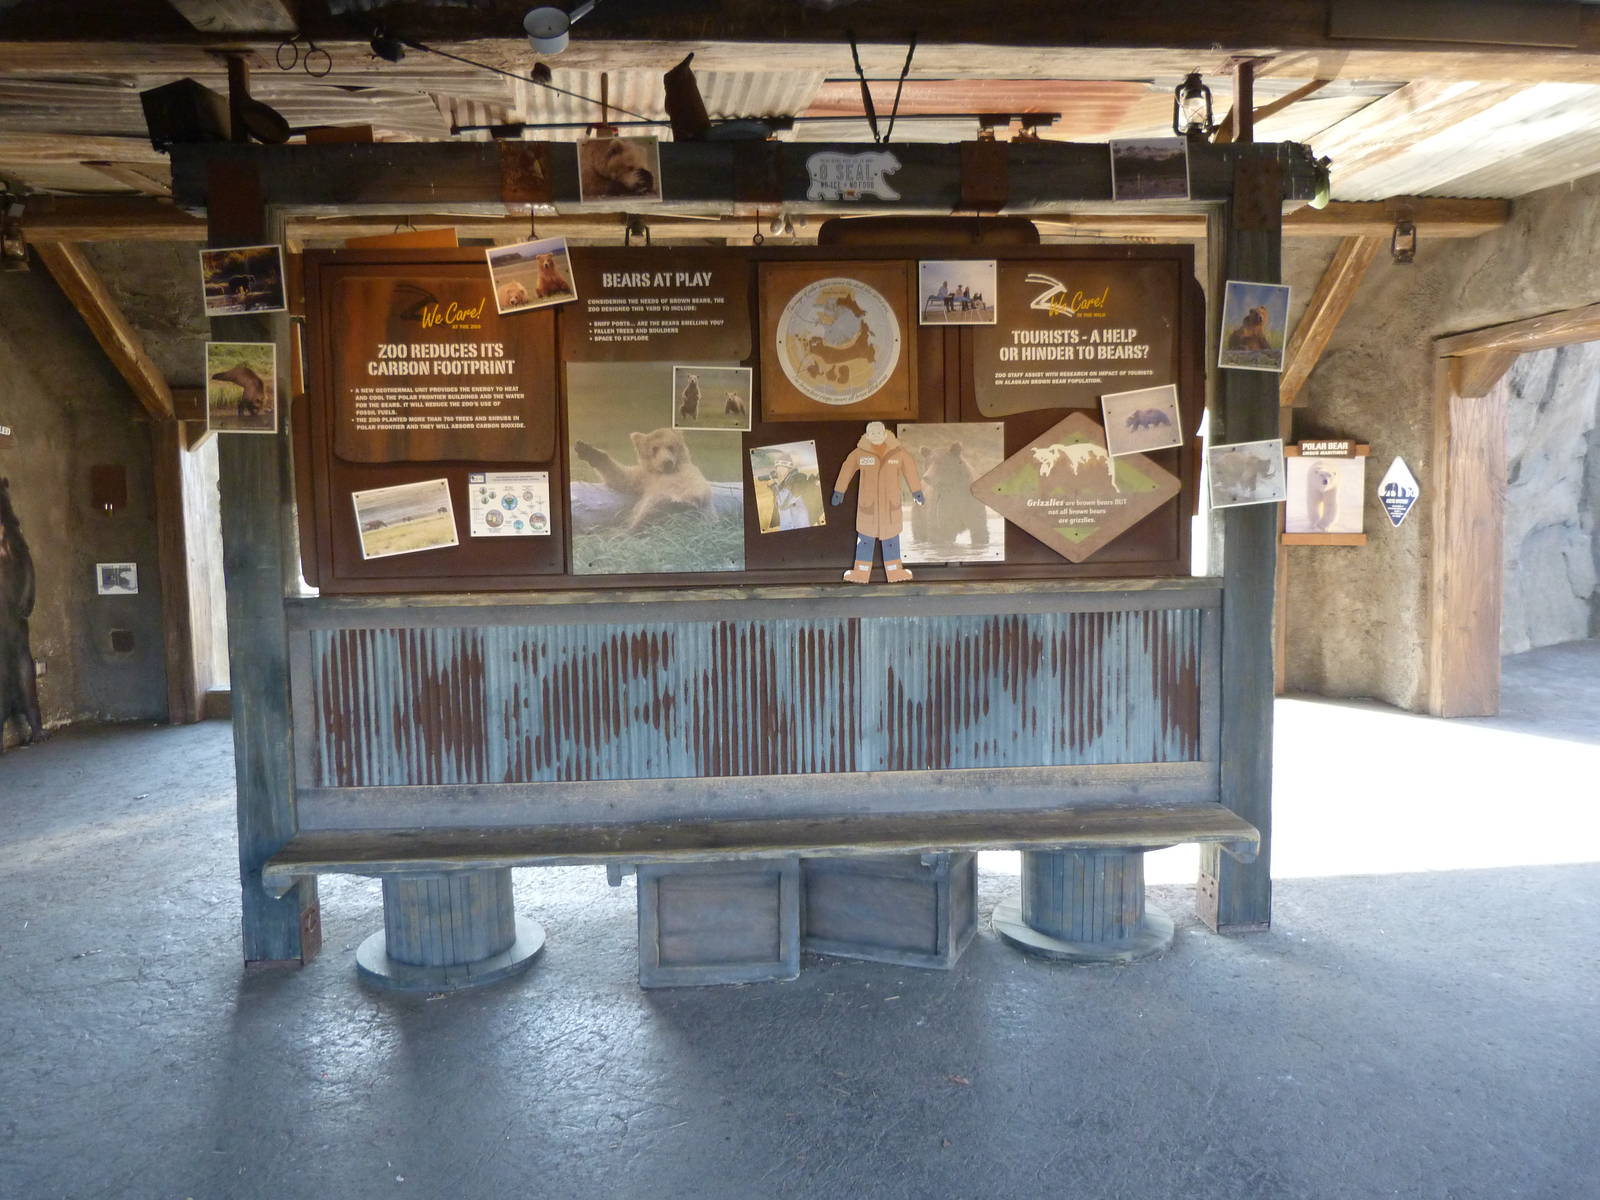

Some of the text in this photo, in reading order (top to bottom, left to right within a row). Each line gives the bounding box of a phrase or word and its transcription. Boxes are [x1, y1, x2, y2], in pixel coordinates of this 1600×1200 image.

[836, 164, 874, 180] SEAL
[602, 272, 712, 287] BEARS AT PLAY
[1049, 288, 1109, 317] We Care!
[422, 297, 486, 328] We Care!
[1012, 330, 1079, 344] TOURISTS
[1090, 330, 1100, 343] A
[1103, 329, 1137, 343] HELP
[378, 343, 504, 358] ZOO REDUCES ITS
[1000, 346, 1149, 361] OR HINDER TO BEARS?
[368, 360, 515, 376] CARBON FOOTPRINT
[1027, 499, 1064, 507] Grizzlies
